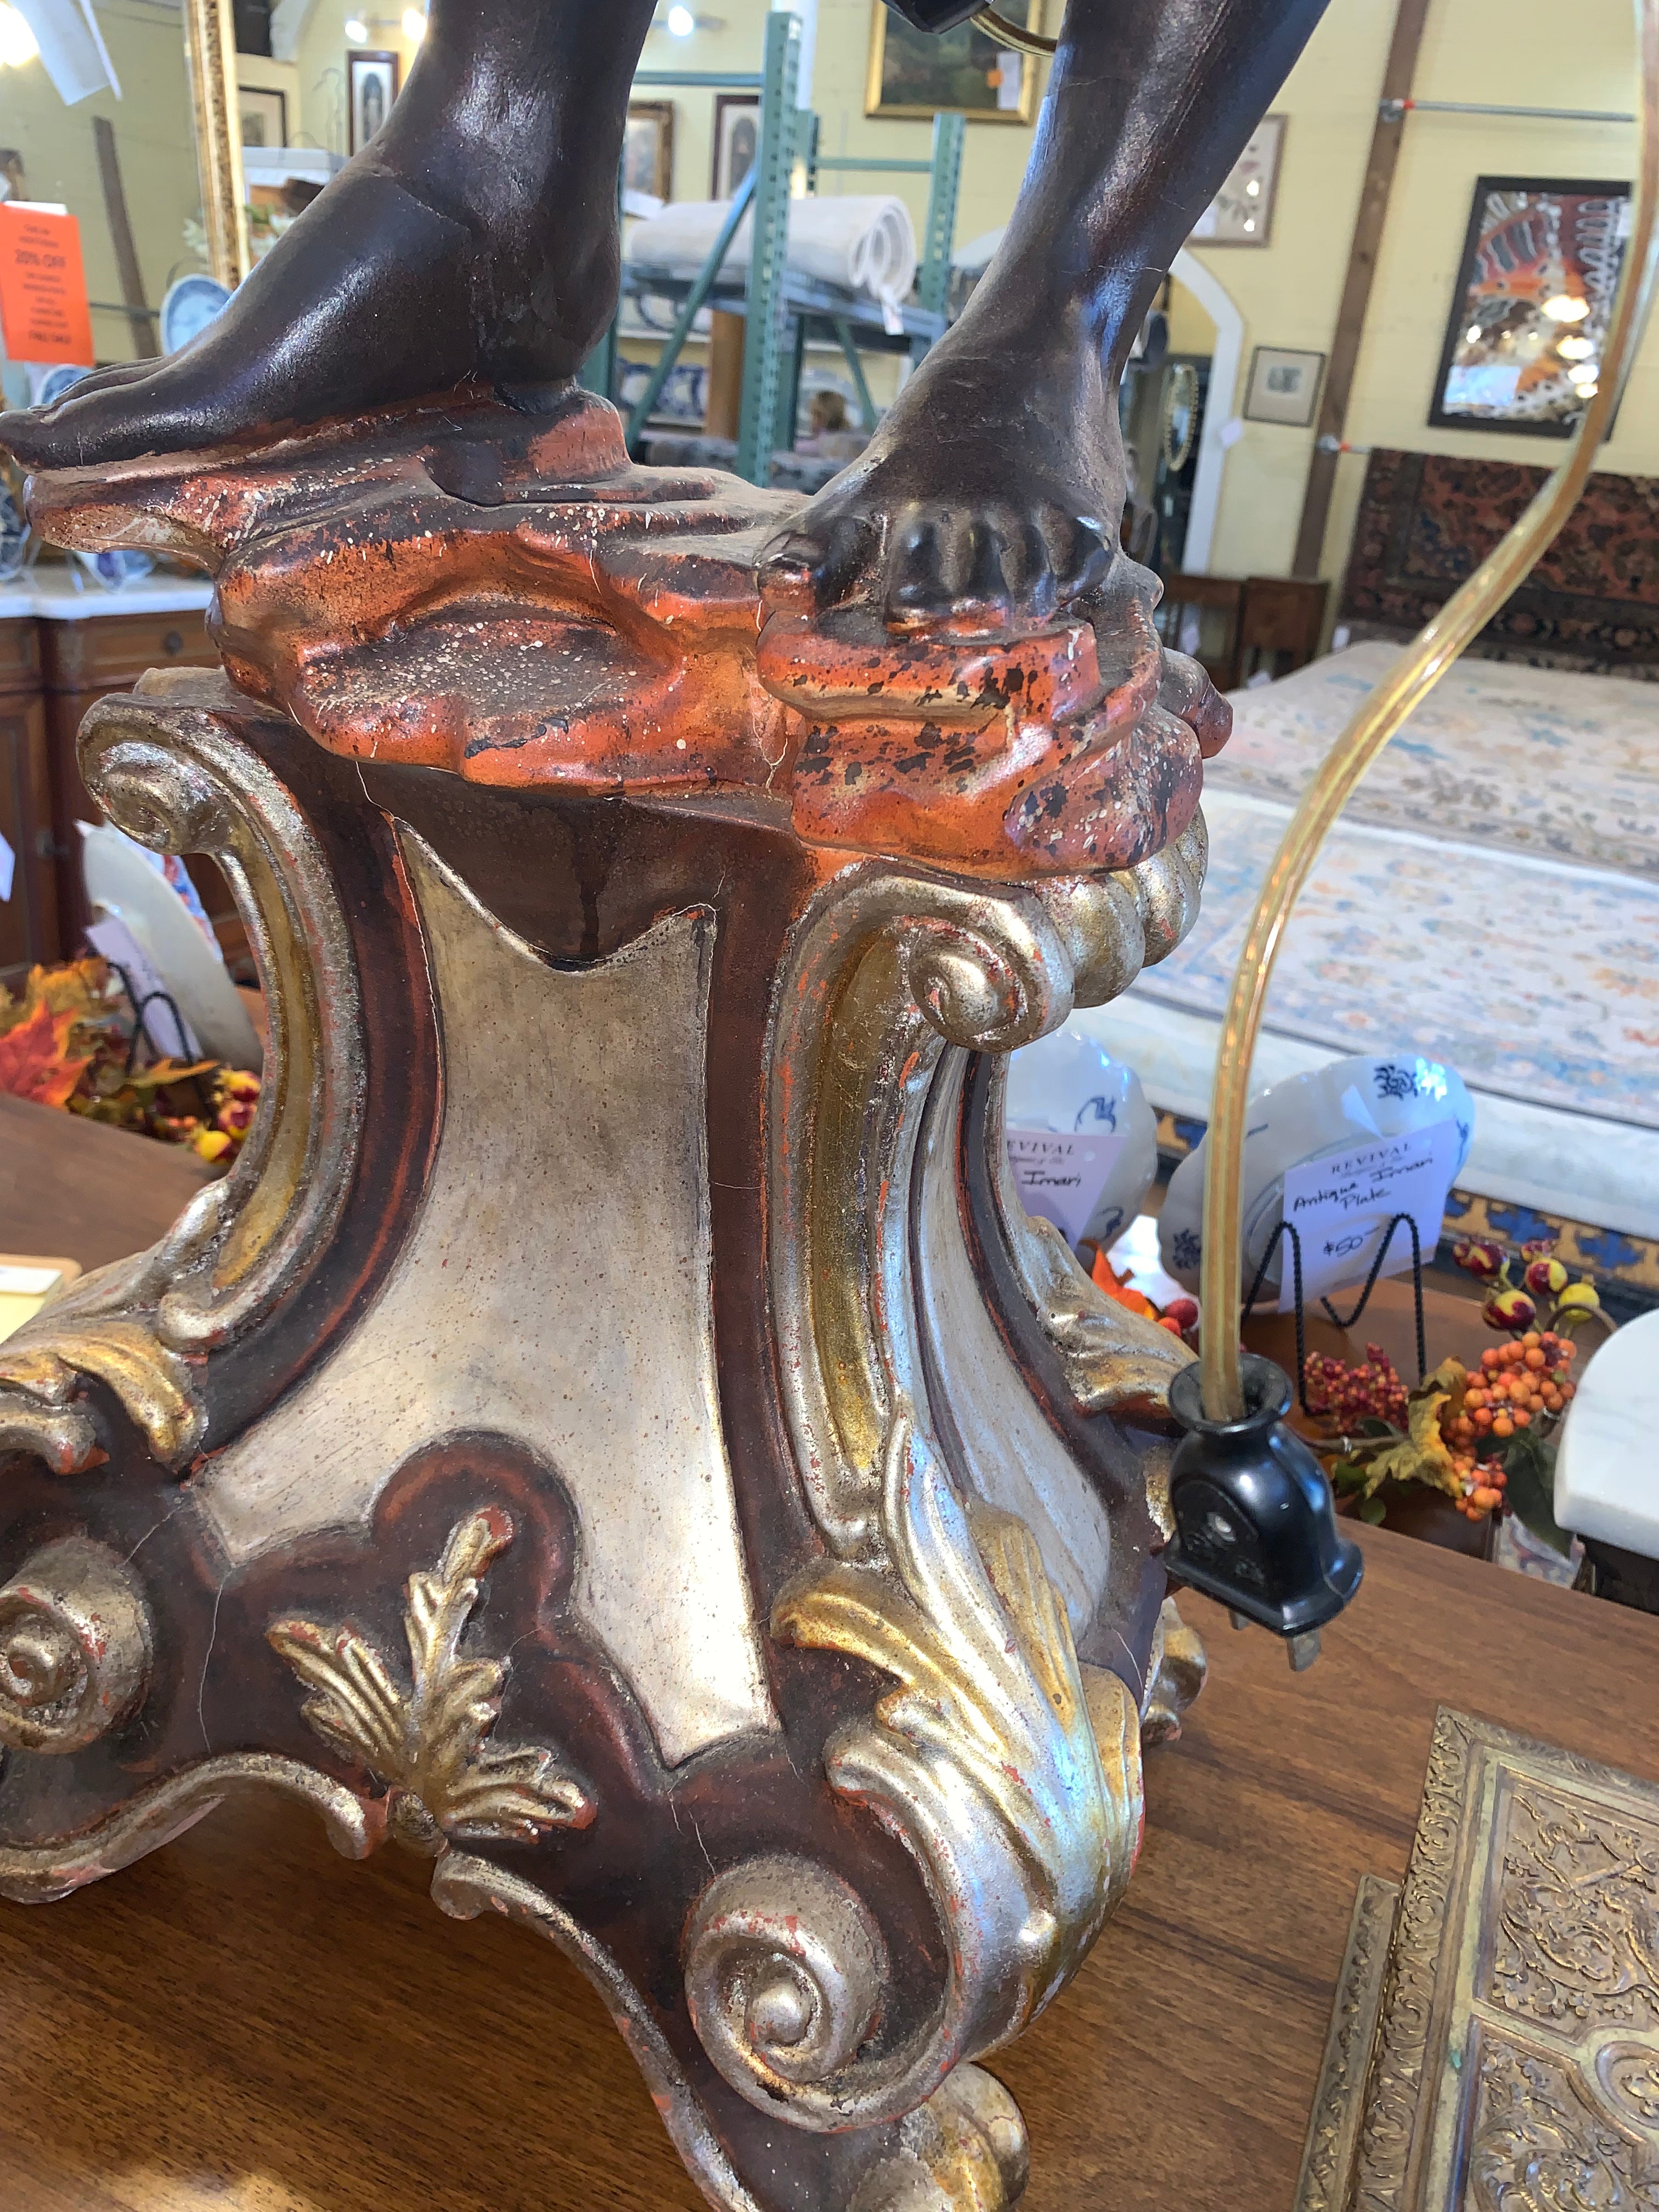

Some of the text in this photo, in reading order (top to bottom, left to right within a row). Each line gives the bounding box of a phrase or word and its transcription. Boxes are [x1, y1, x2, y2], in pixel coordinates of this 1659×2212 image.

[1007, 1139, 1074, 1155] EVIVAL
[1331, 1142, 1412, 1174] REVIVAL
[1293, 1182, 1358, 1212] Antique
